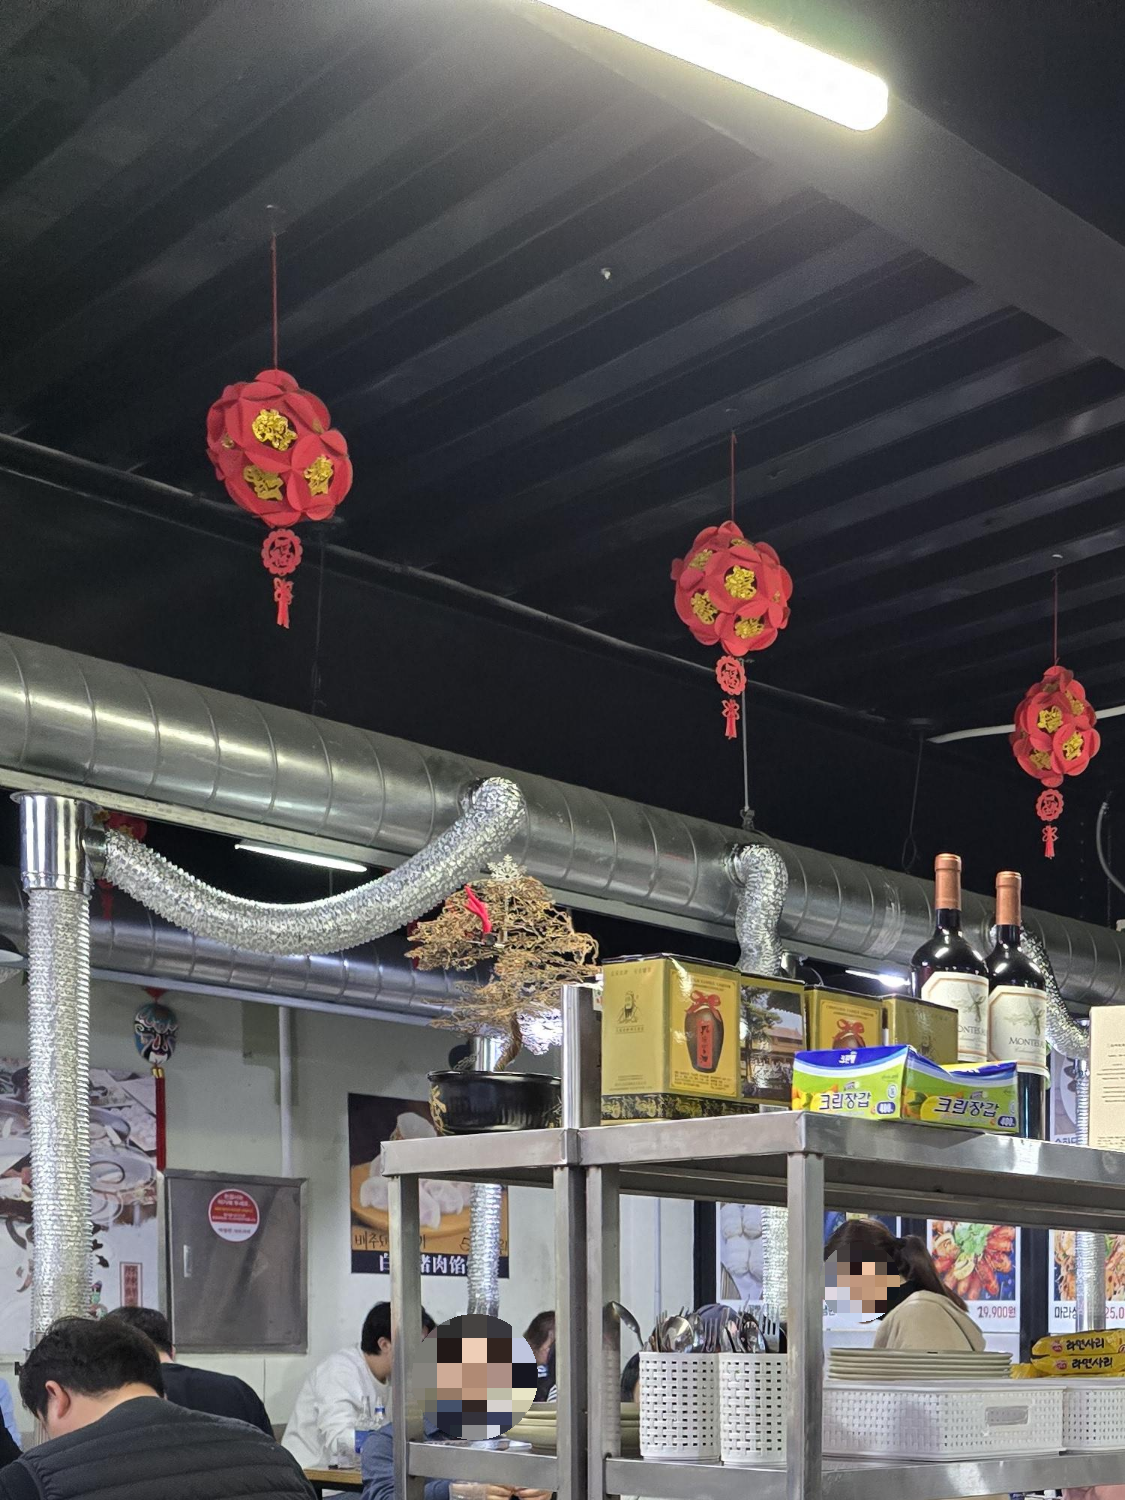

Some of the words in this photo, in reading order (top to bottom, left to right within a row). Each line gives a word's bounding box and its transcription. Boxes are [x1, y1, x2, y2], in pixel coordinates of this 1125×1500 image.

[819, 1092, 871, 1110] 크린장갑
[934, 1097, 1000, 1117] 크린장갑
[1066, 1337, 1105, 1351] 라면사리
[1072, 1357, 1113, 1369] 라면사리
